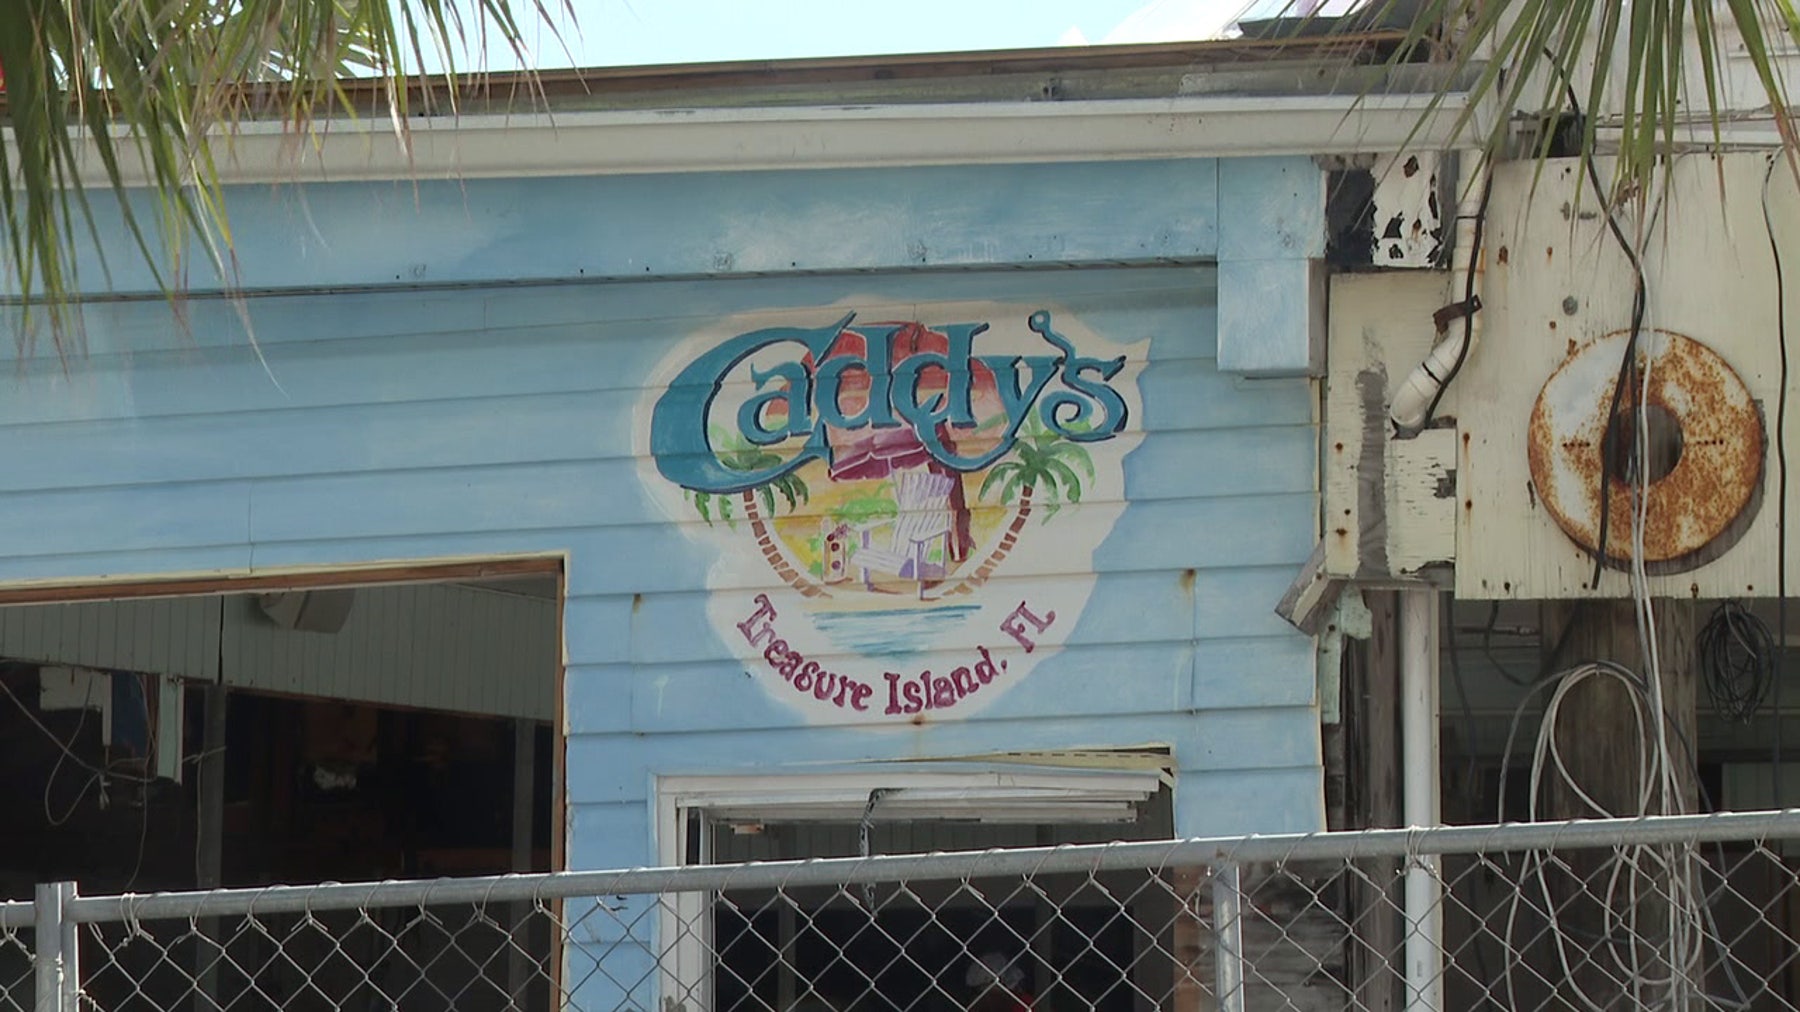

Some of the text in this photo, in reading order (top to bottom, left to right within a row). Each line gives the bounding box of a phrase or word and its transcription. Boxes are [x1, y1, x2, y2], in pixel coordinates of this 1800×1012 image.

[651, 310, 1129, 493] Caddy's
[737, 594, 873, 711] Treasure
[1000, 601, 1056, 653] FL
